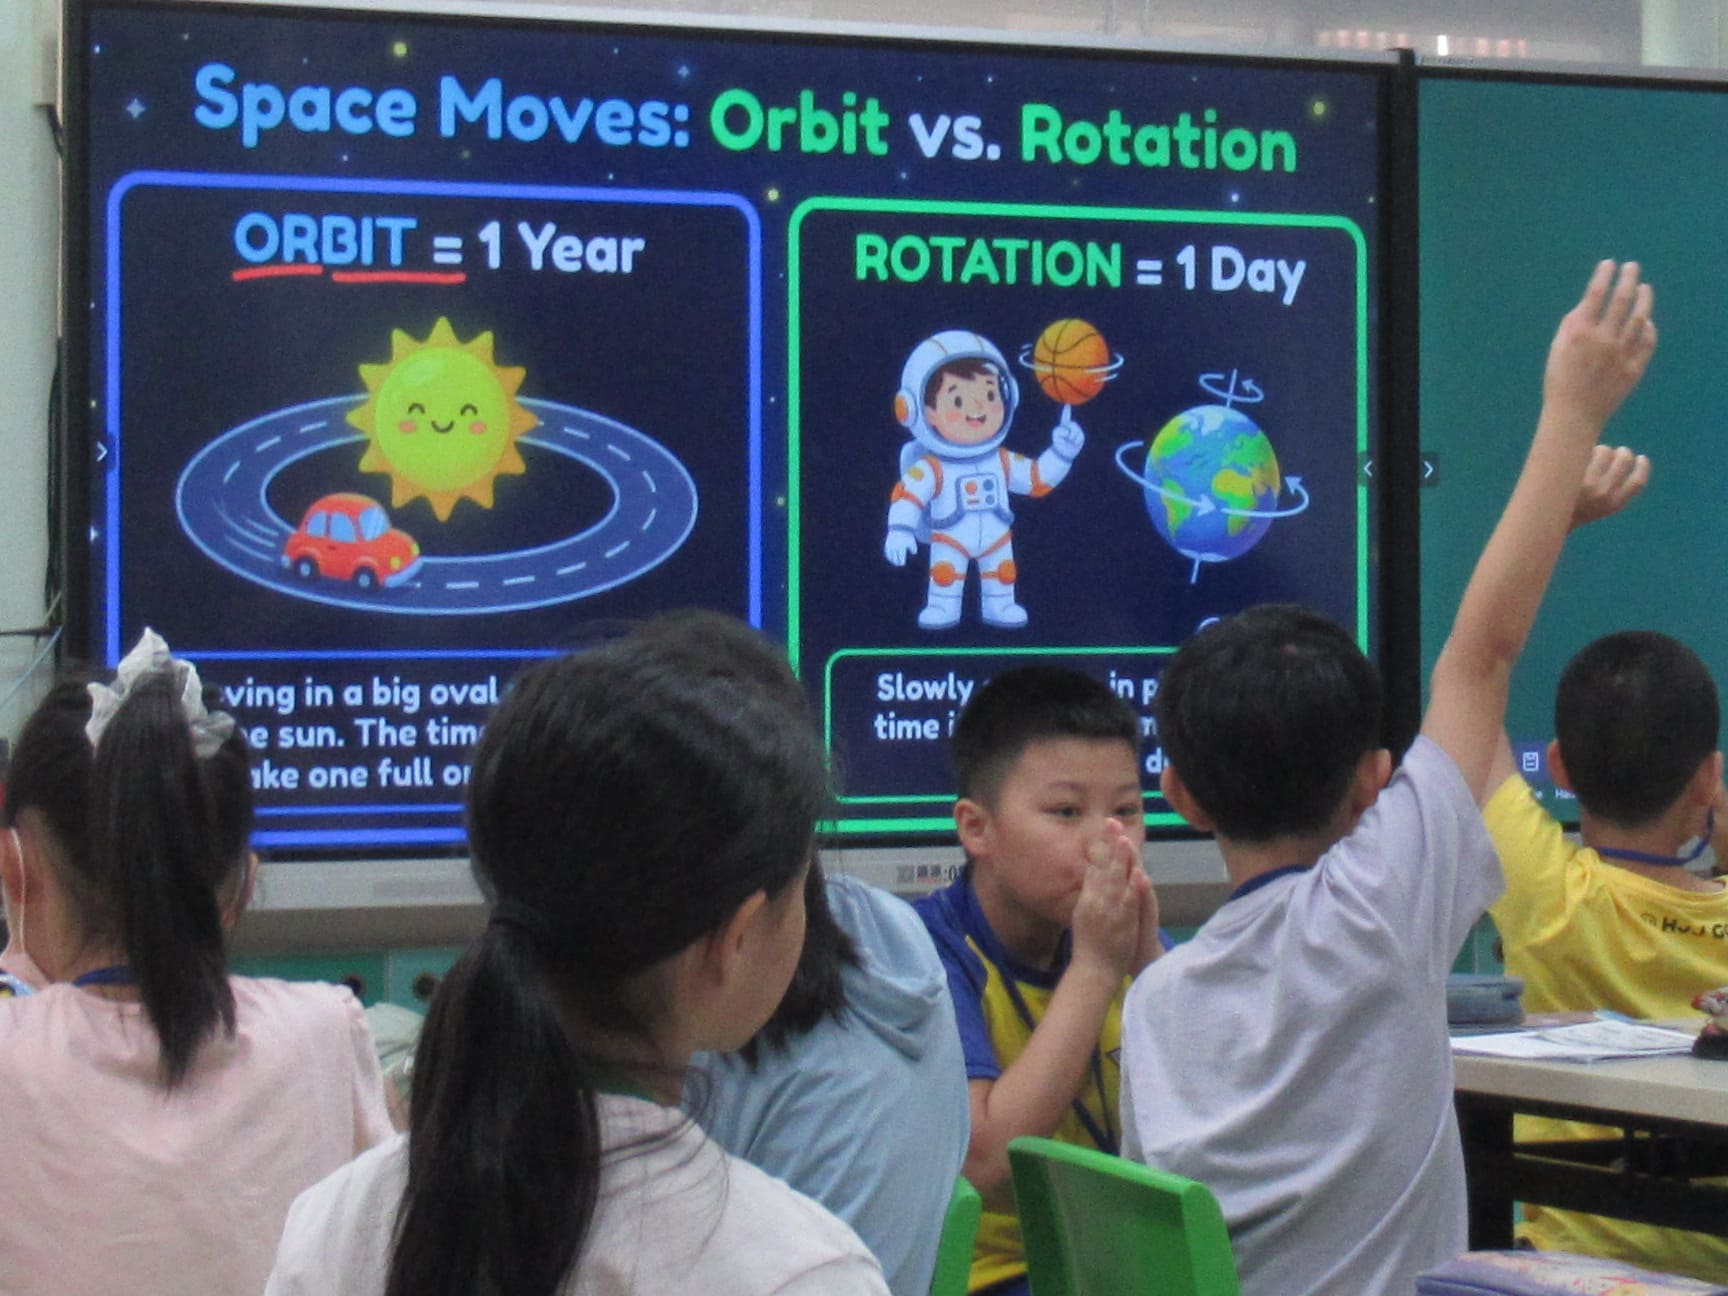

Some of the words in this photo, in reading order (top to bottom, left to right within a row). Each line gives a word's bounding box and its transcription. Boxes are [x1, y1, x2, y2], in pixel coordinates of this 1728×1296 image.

[192, 60, 418, 150] Space
[436, 73, 692, 150] Moves:
[709, 88, 891, 157] Orbit
[907, 111, 1003, 162] vs.
[1021, 103, 1298, 174] Rotation
[233, 210, 419, 267] ORBIT
[476, 219, 502, 271] 1
[516, 220, 647, 275] Year
[854, 232, 1123, 289] ROTATION
[1174, 242, 1198, 291] 1
[1210, 243, 1308, 308] Day
[221, 676, 296, 714] ving
[305, 677, 334, 707] in
[343, 684, 364, 706] a
[372, 676, 421, 713] big
[429, 675, 500, 706] oval
[876, 671, 975, 705] Slowly
[278, 726, 345, 749] sun.
[353, 716, 417, 748] The
[873, 712, 940, 741] time
[308, 764, 369, 788] one
[377, 755, 435, 787] full
